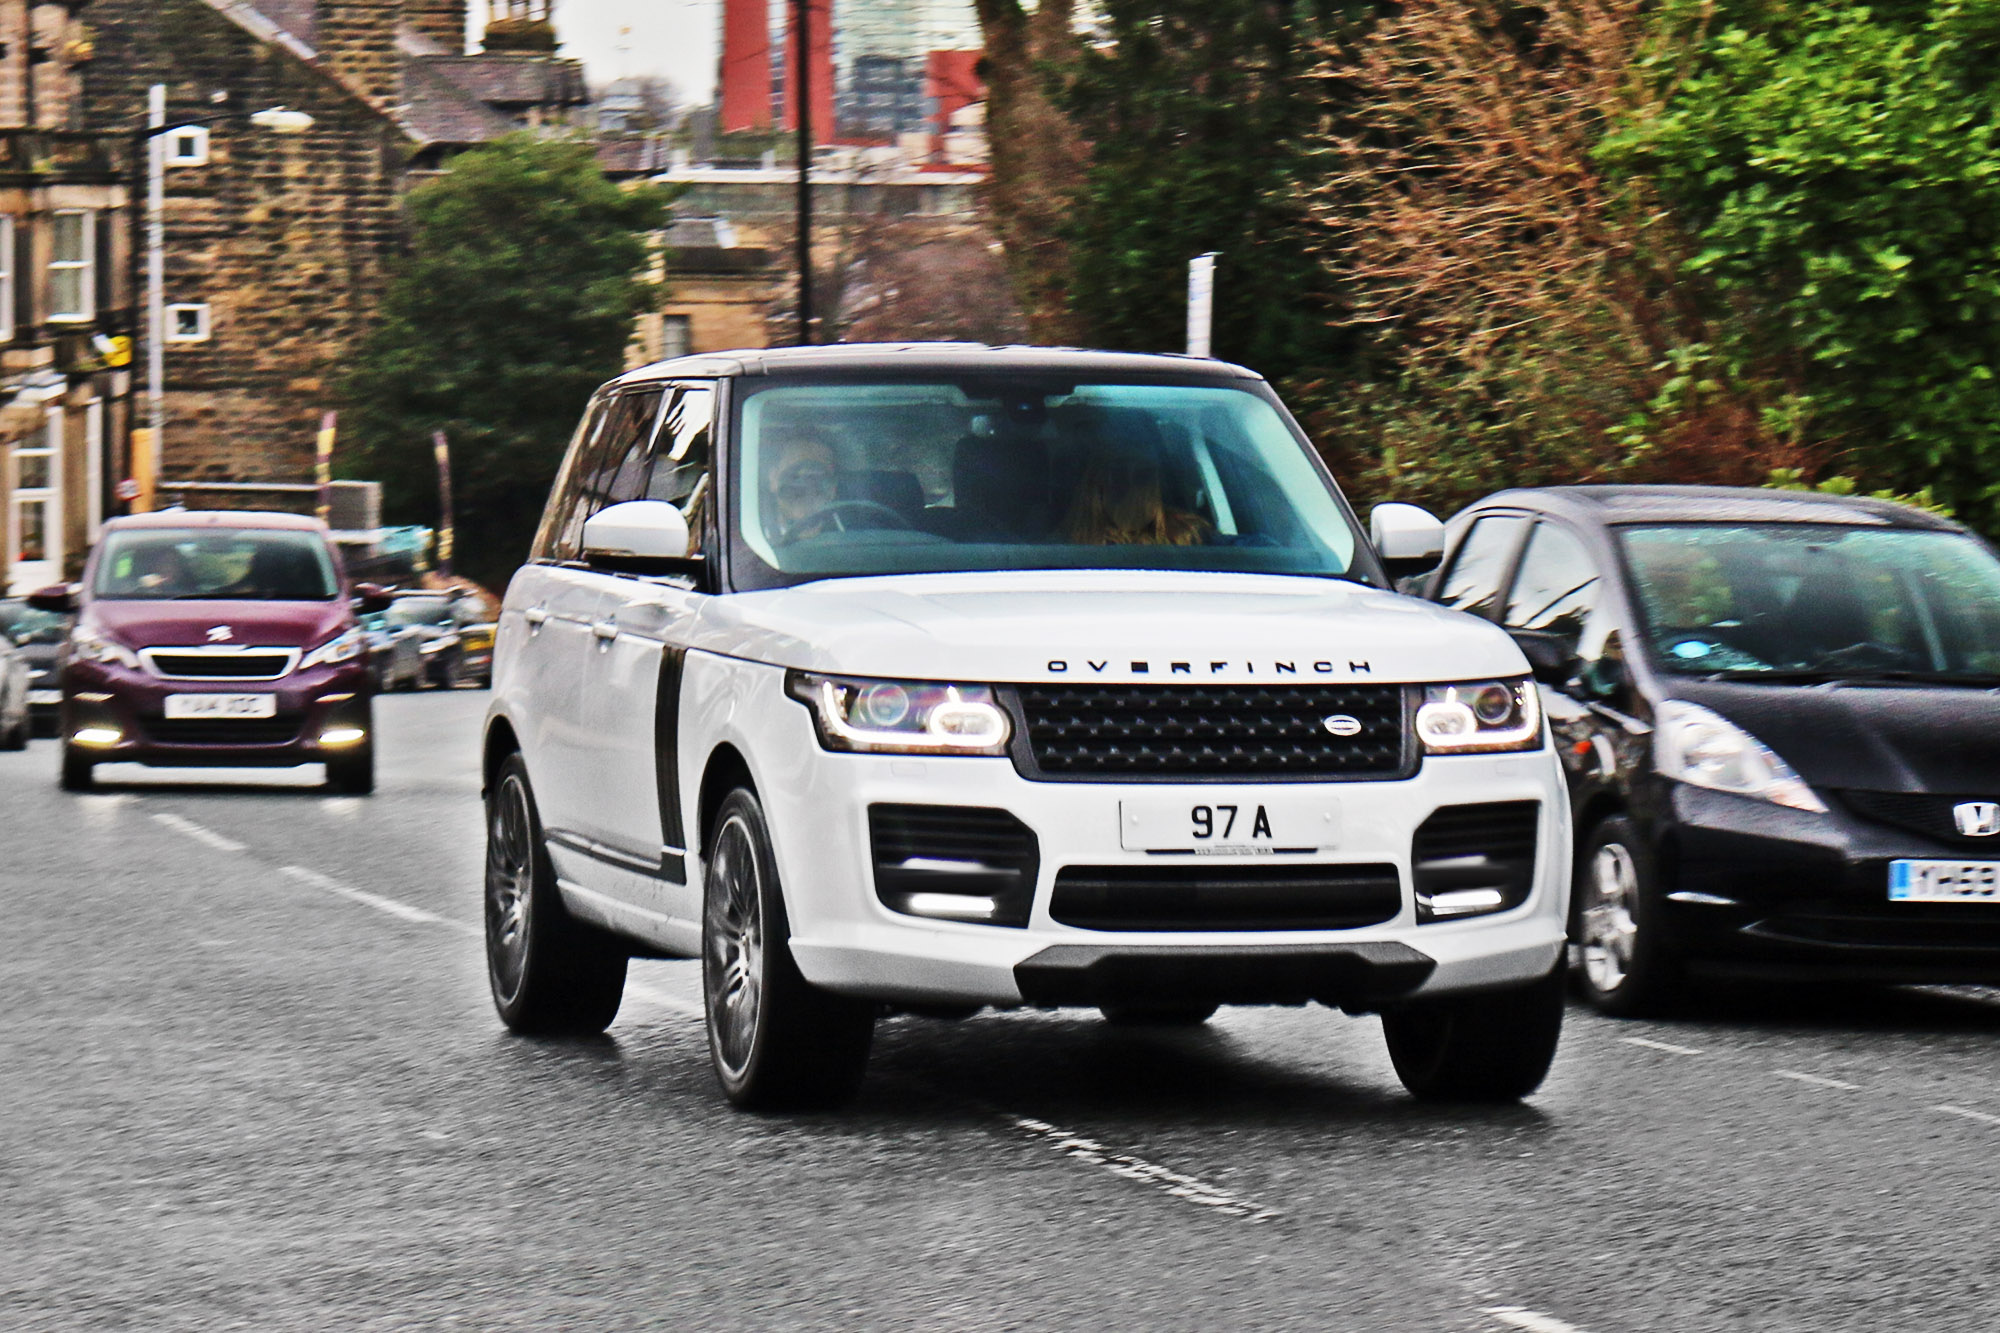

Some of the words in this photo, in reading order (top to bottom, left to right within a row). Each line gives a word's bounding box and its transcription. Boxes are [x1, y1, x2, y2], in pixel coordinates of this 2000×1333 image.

[1047, 660, 1371, 674] OVERFINCH
[1192, 806, 1237, 838] 97
[1253, 805, 1272, 838] A
